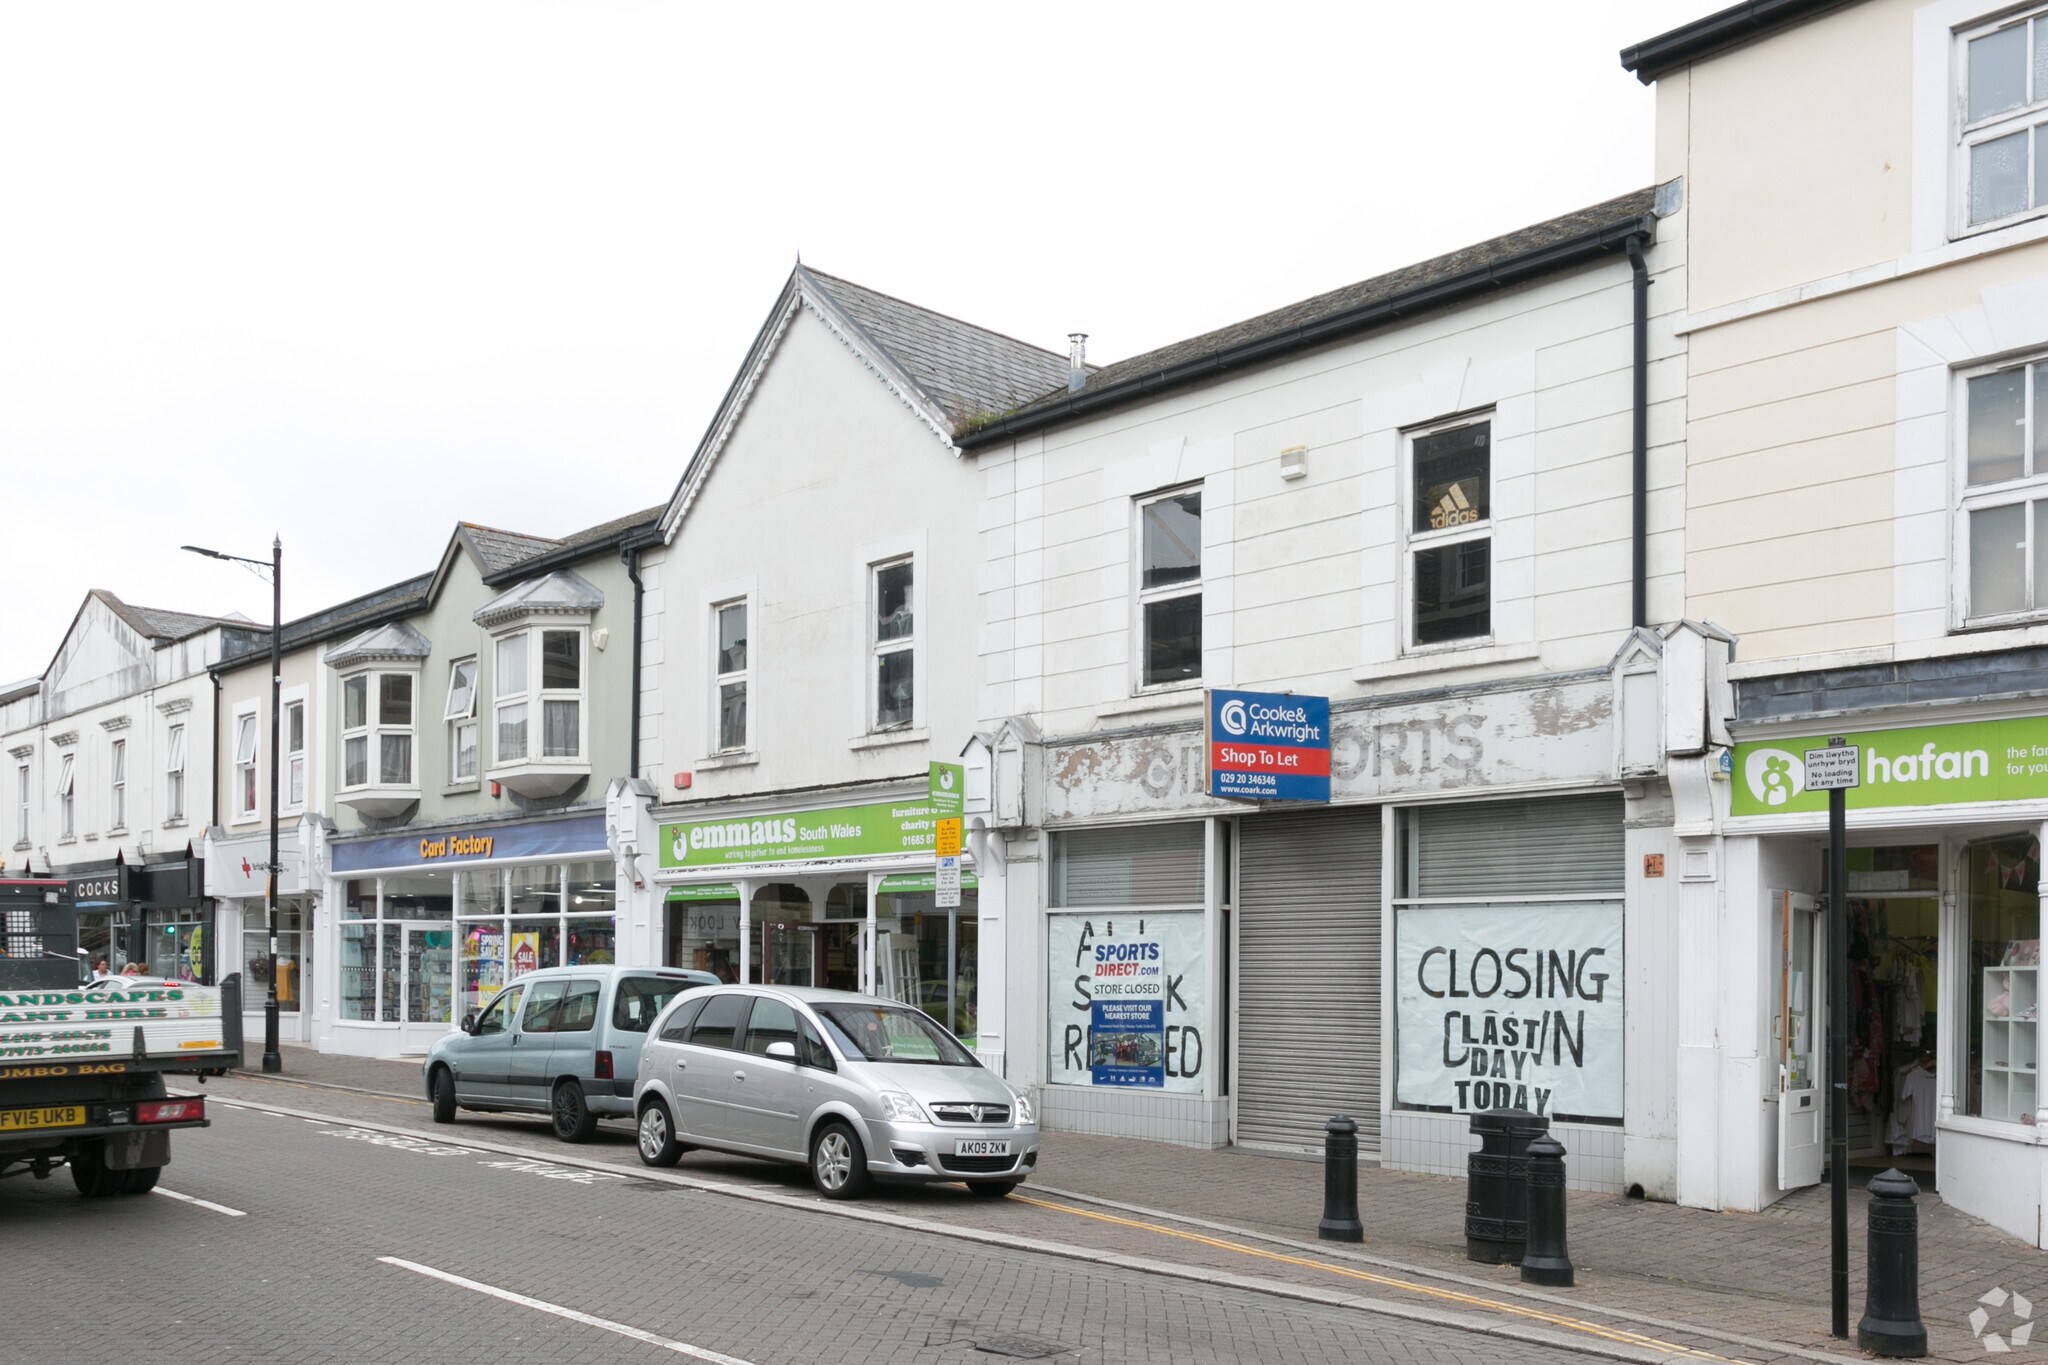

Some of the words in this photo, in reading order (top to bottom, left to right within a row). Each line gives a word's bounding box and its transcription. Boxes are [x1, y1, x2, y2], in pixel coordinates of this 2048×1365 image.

[1249, 704, 1307, 723] Cooke&
[1250, 721, 1320, 742] Arkwright
[1221, 748, 1256, 767] Shop
[1259, 750, 1274, 765] To
[1277, 751, 1298, 766] Let
[1826, 750, 1854, 758] llwytho
[2006, 746, 2027, 759] the
[1867, 742, 1988, 784] hafan
[2006, 762, 2024, 775] for
[1220, 773, 1235, 783] 029
[1237, 774, 1246, 783] 20
[1248, 774, 1276, 785] 346346
[1825, 769, 1853, 777] loading
[1837, 777, 1853, 785] time
[1220, 785, 1277, 795] www.coark.com
[892, 807, 929, 818] furniture
[901, 820, 929, 830] charity
[690, 818, 796, 850] emmaus
[800, 826, 827, 841] South
[829, 823, 861, 839] Wales
[902, 834, 925, 846] 01685
[420, 837, 446, 858] Card
[450, 834, 493, 858] Factory
[75, 881, 118, 897] COCKS
[481, 934, 503, 946] SPRING
[518, 951, 533, 963] SALE
[1095, 942, 1159, 962] SPORTS
[1095, 963, 1159, 976] DIRECT.COM
[1418, 946, 1610, 1003] CLOSING
[1094, 984, 1122, 994] STORE
[1125, 983, 1160, 994] CLOSED
[0, 990, 184, 1007] ANDSCAPES
[0, 1010, 73, 1022] ANT
[85, 1007, 168, 1020] HIRE
[1102, 1004, 1124, 1012] PLEASE
[1124, 1004, 1138, 1012] VISIT
[1138, 1004, 1152, 1012] OUR
[1104, 1012, 1130, 1020] NEAREST
[1131, 1012, 1150, 1020] STORE
[1462, 1014, 1541, 1049] LAST
[1470, 1047, 1528, 1080] DAY
[0, 1065, 69, 1079] UMBO
[79, 1063, 126, 1075] BAG
[1455, 1080, 1552, 1117] TODAY
[1, 1110, 38, 1126] FV15
[43, 1107, 76, 1124] UKB
[961, 1142, 987, 1154] AK09
[989, 1142, 1007, 1154] ZKW
